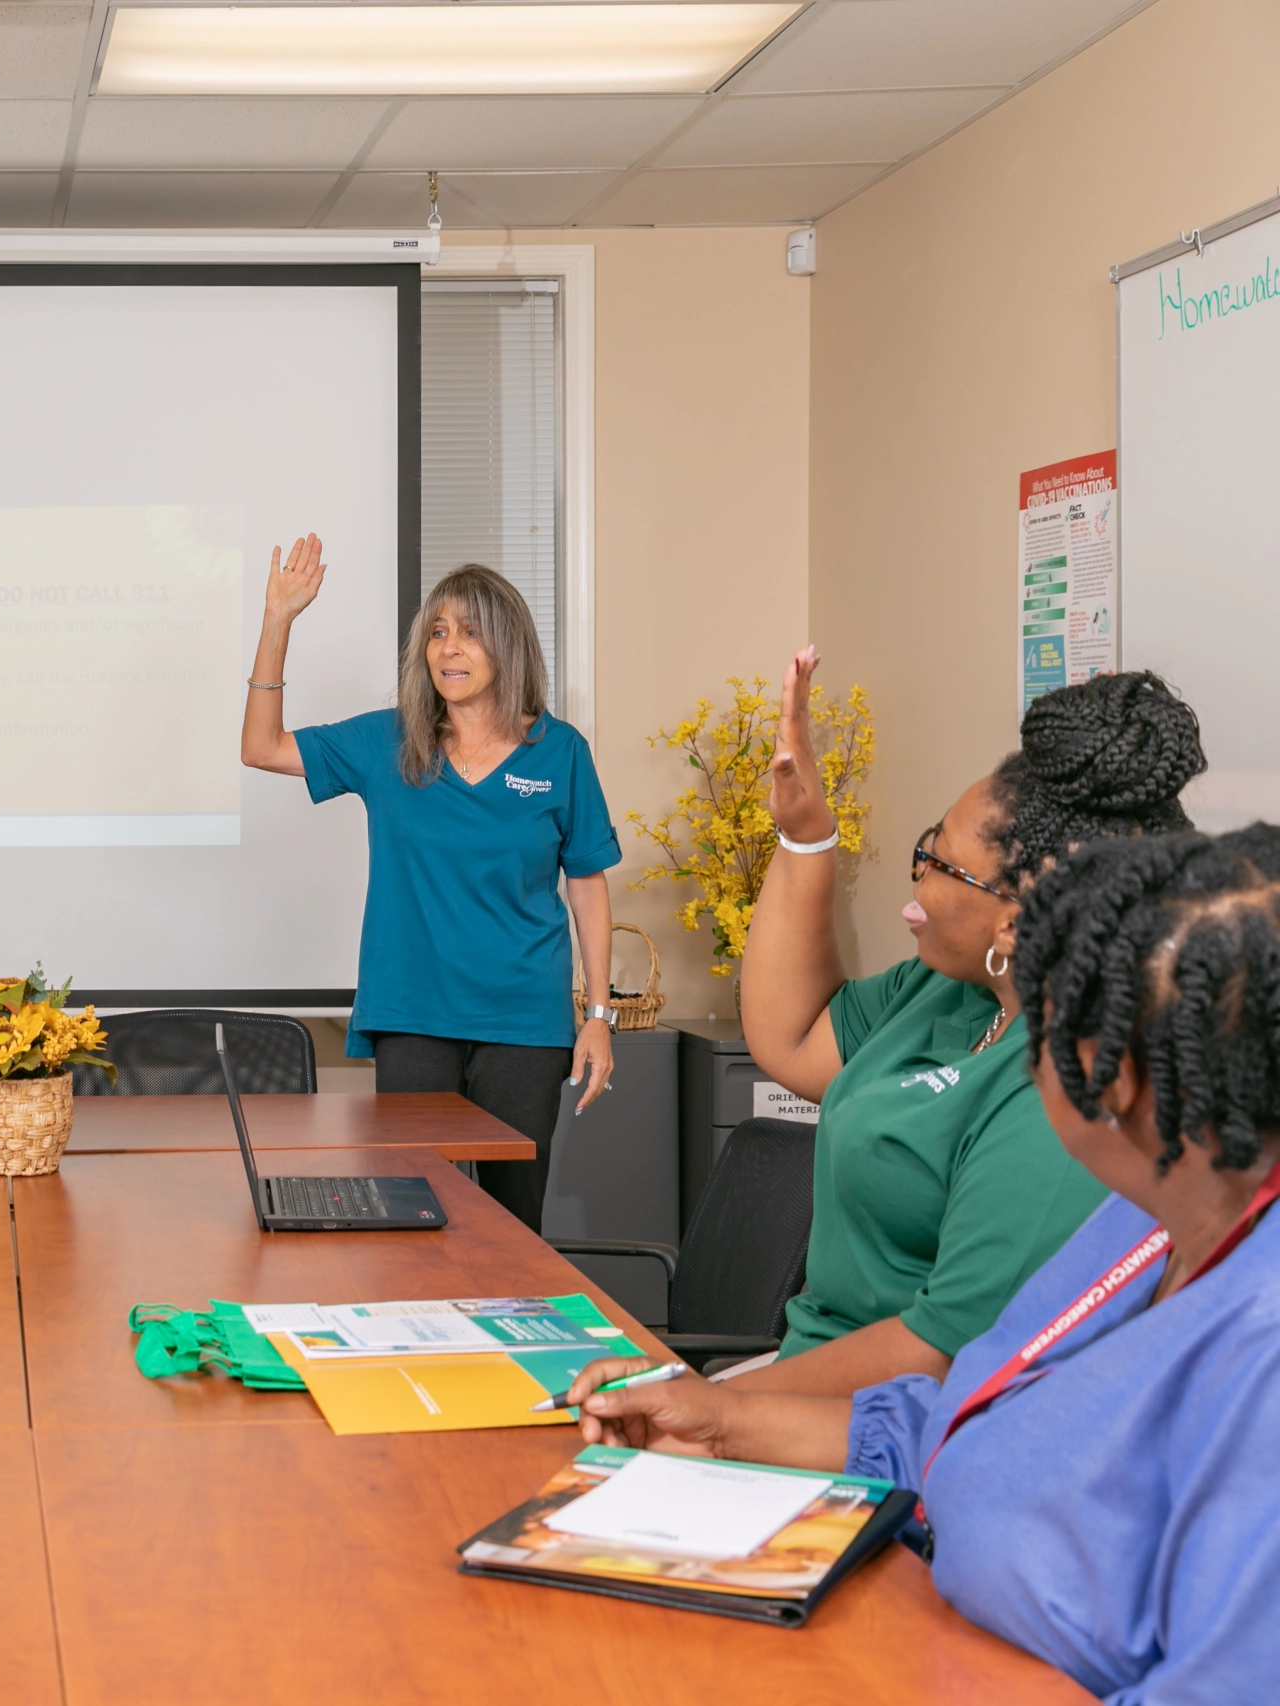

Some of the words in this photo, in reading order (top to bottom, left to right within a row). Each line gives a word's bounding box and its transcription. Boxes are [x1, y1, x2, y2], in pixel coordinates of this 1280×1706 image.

[1158, 255, 1280, 341] Homewatc
[1052, 474, 1064, 487] Need
[1070, 471, 1086, 484] Know
[1087, 466, 1104, 480] About
[1027, 489, 1058, 509] COVID-19
[1056, 477, 1112, 502] VACCINATIONS
[1070, 504, 1082, 512] FACT
[1070, 512, 1085, 521] CHECK
[30, 585, 70, 603] NOT
[74, 584, 126, 603] CALL
[131, 584, 171, 603] 911
[504, 773, 552, 787] Homewatch
